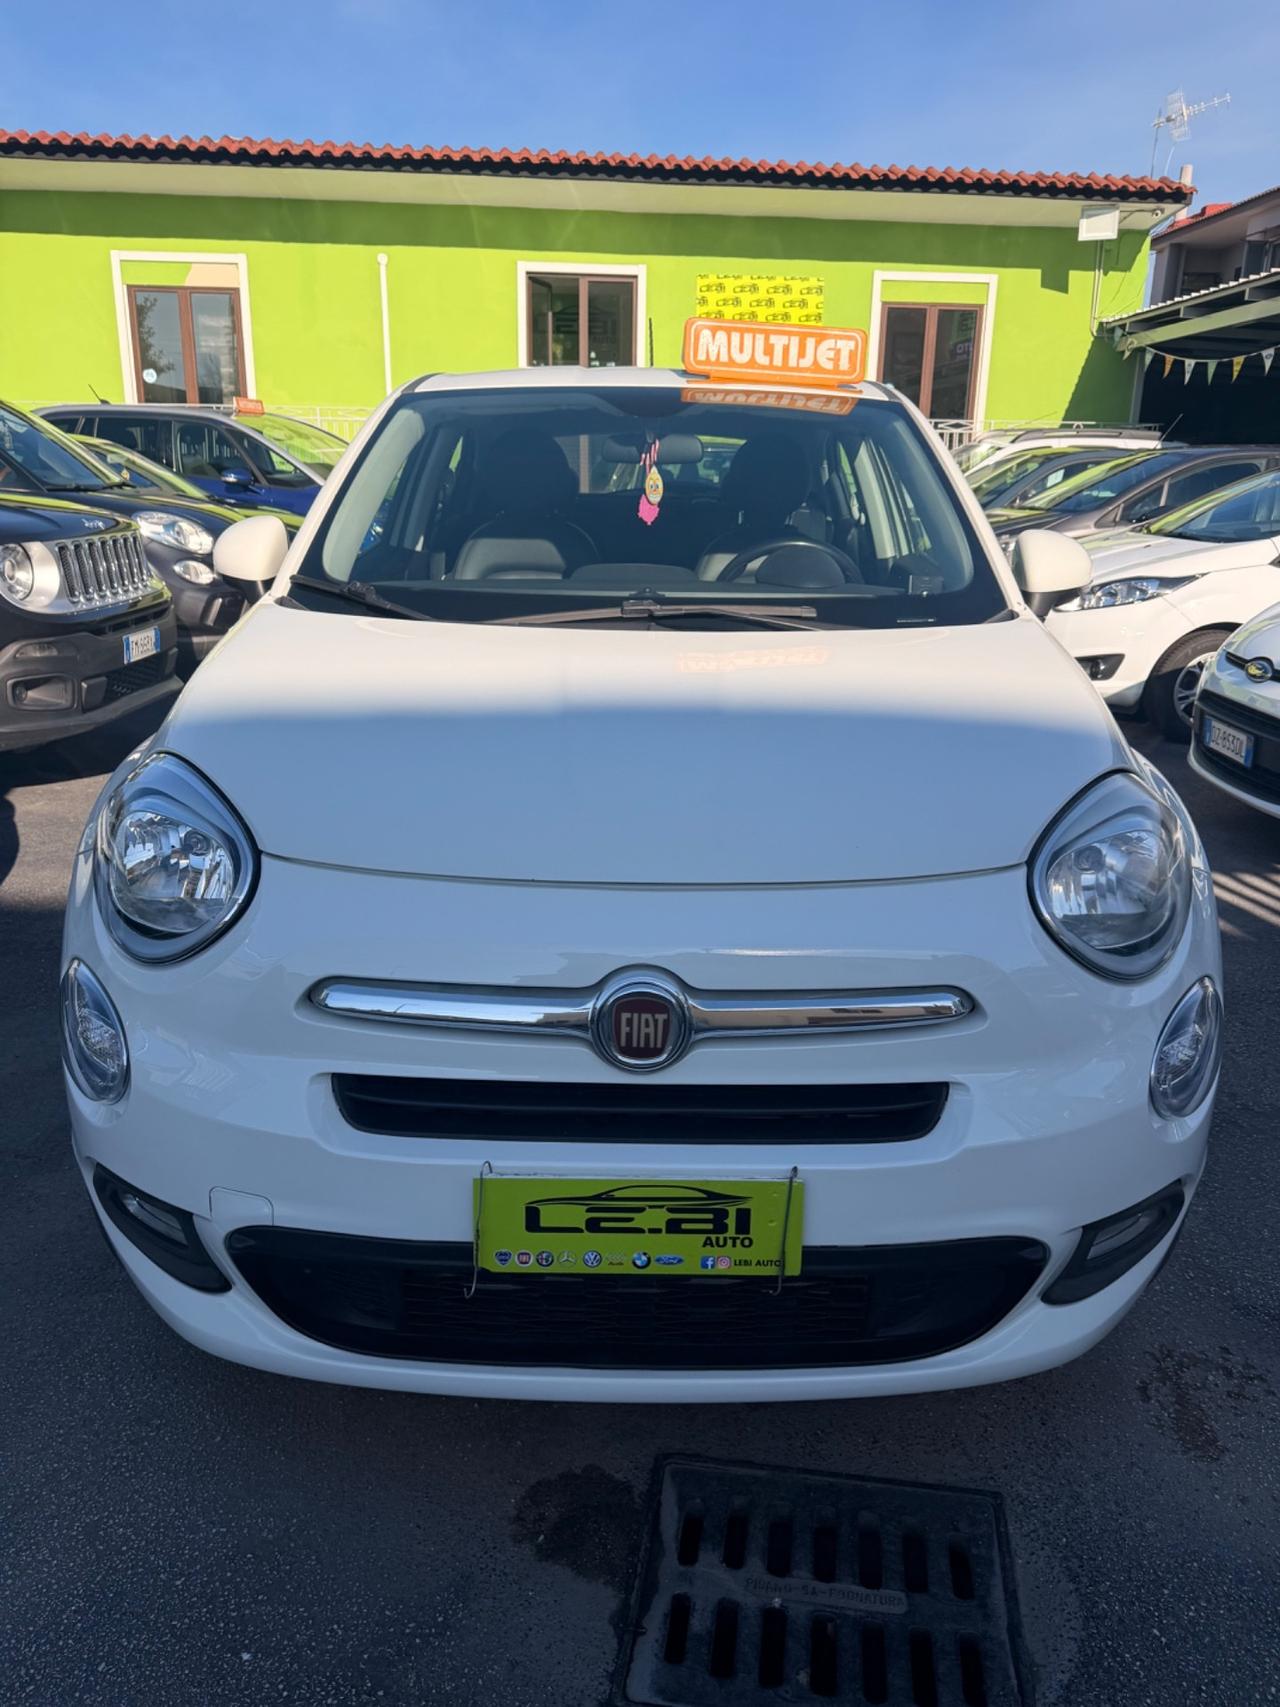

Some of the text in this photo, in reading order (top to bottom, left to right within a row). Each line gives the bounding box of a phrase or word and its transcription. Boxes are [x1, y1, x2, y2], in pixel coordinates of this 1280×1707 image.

[697, 328, 855, 371] MULTIJET
[620, 1012, 668, 1049] FIAT
[702, 1236, 753, 1249] AUTO
